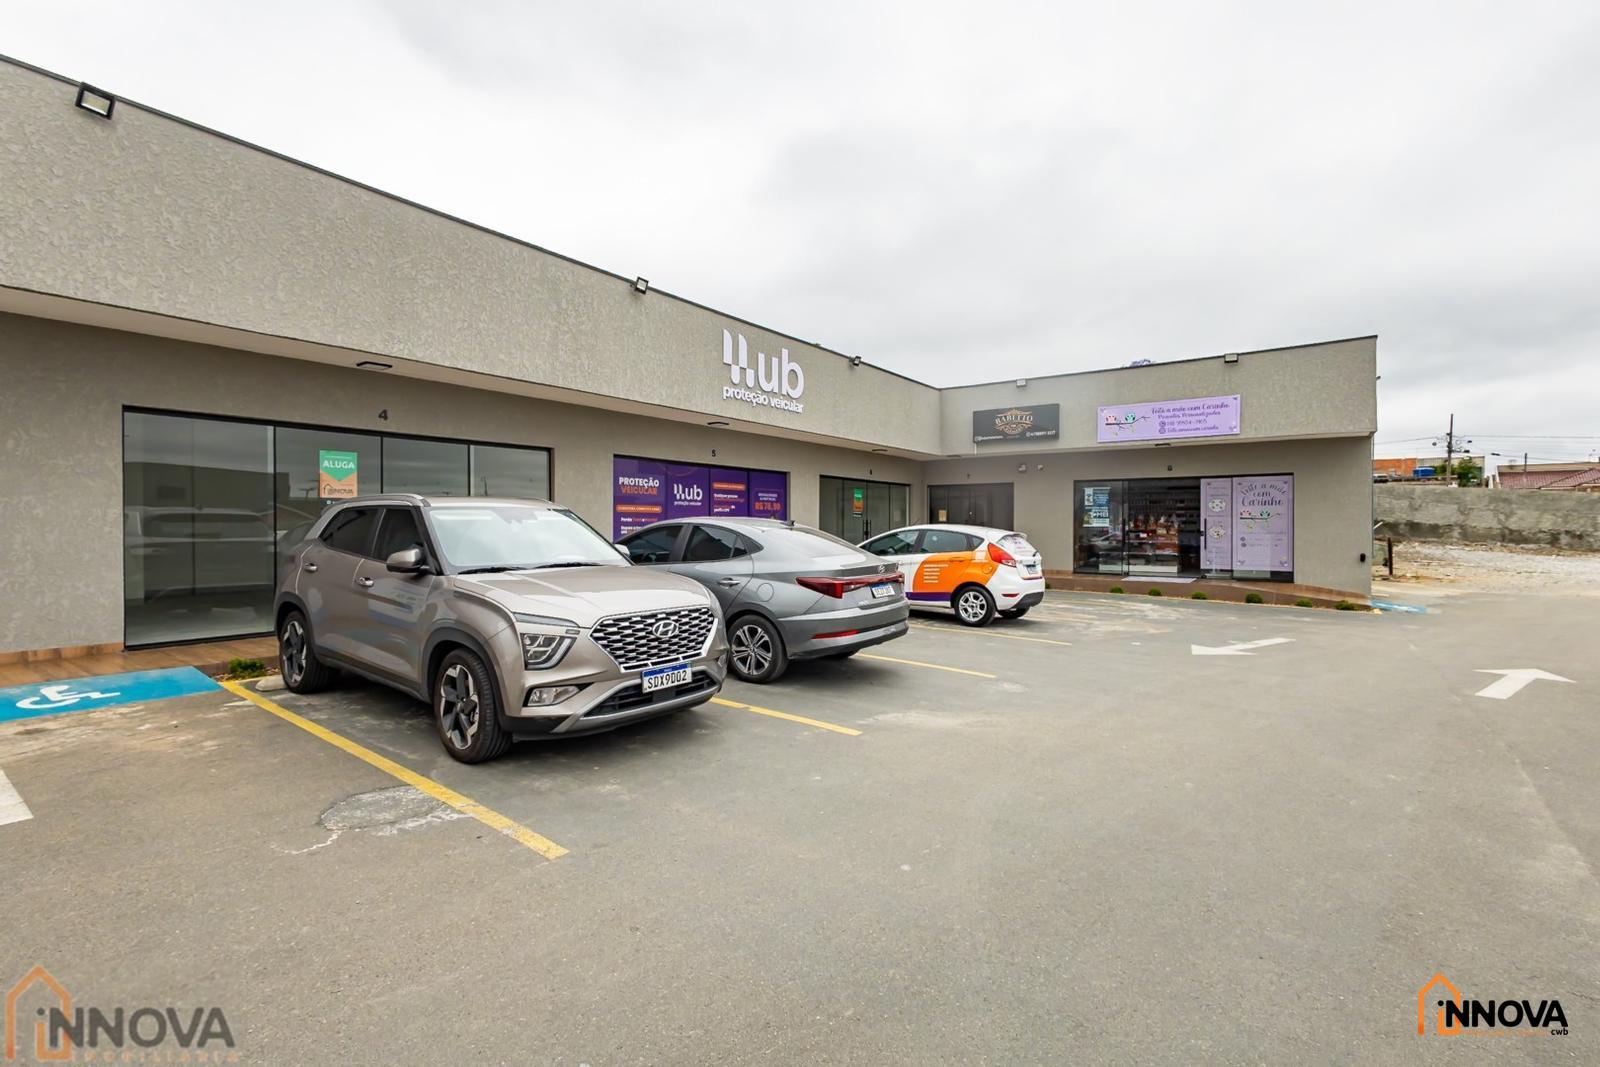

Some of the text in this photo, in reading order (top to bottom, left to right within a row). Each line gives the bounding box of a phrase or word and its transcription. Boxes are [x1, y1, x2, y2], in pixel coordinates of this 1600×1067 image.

[723, 386, 804, 413] proteção veicular
[378, 409, 388, 421] 4
[711, 449, 716, 457] 5
[323, 460, 355, 469] ALUGA
[619, 477, 659, 488] PROTEÇÃO
[621, 486, 658, 495] VEICULAR
